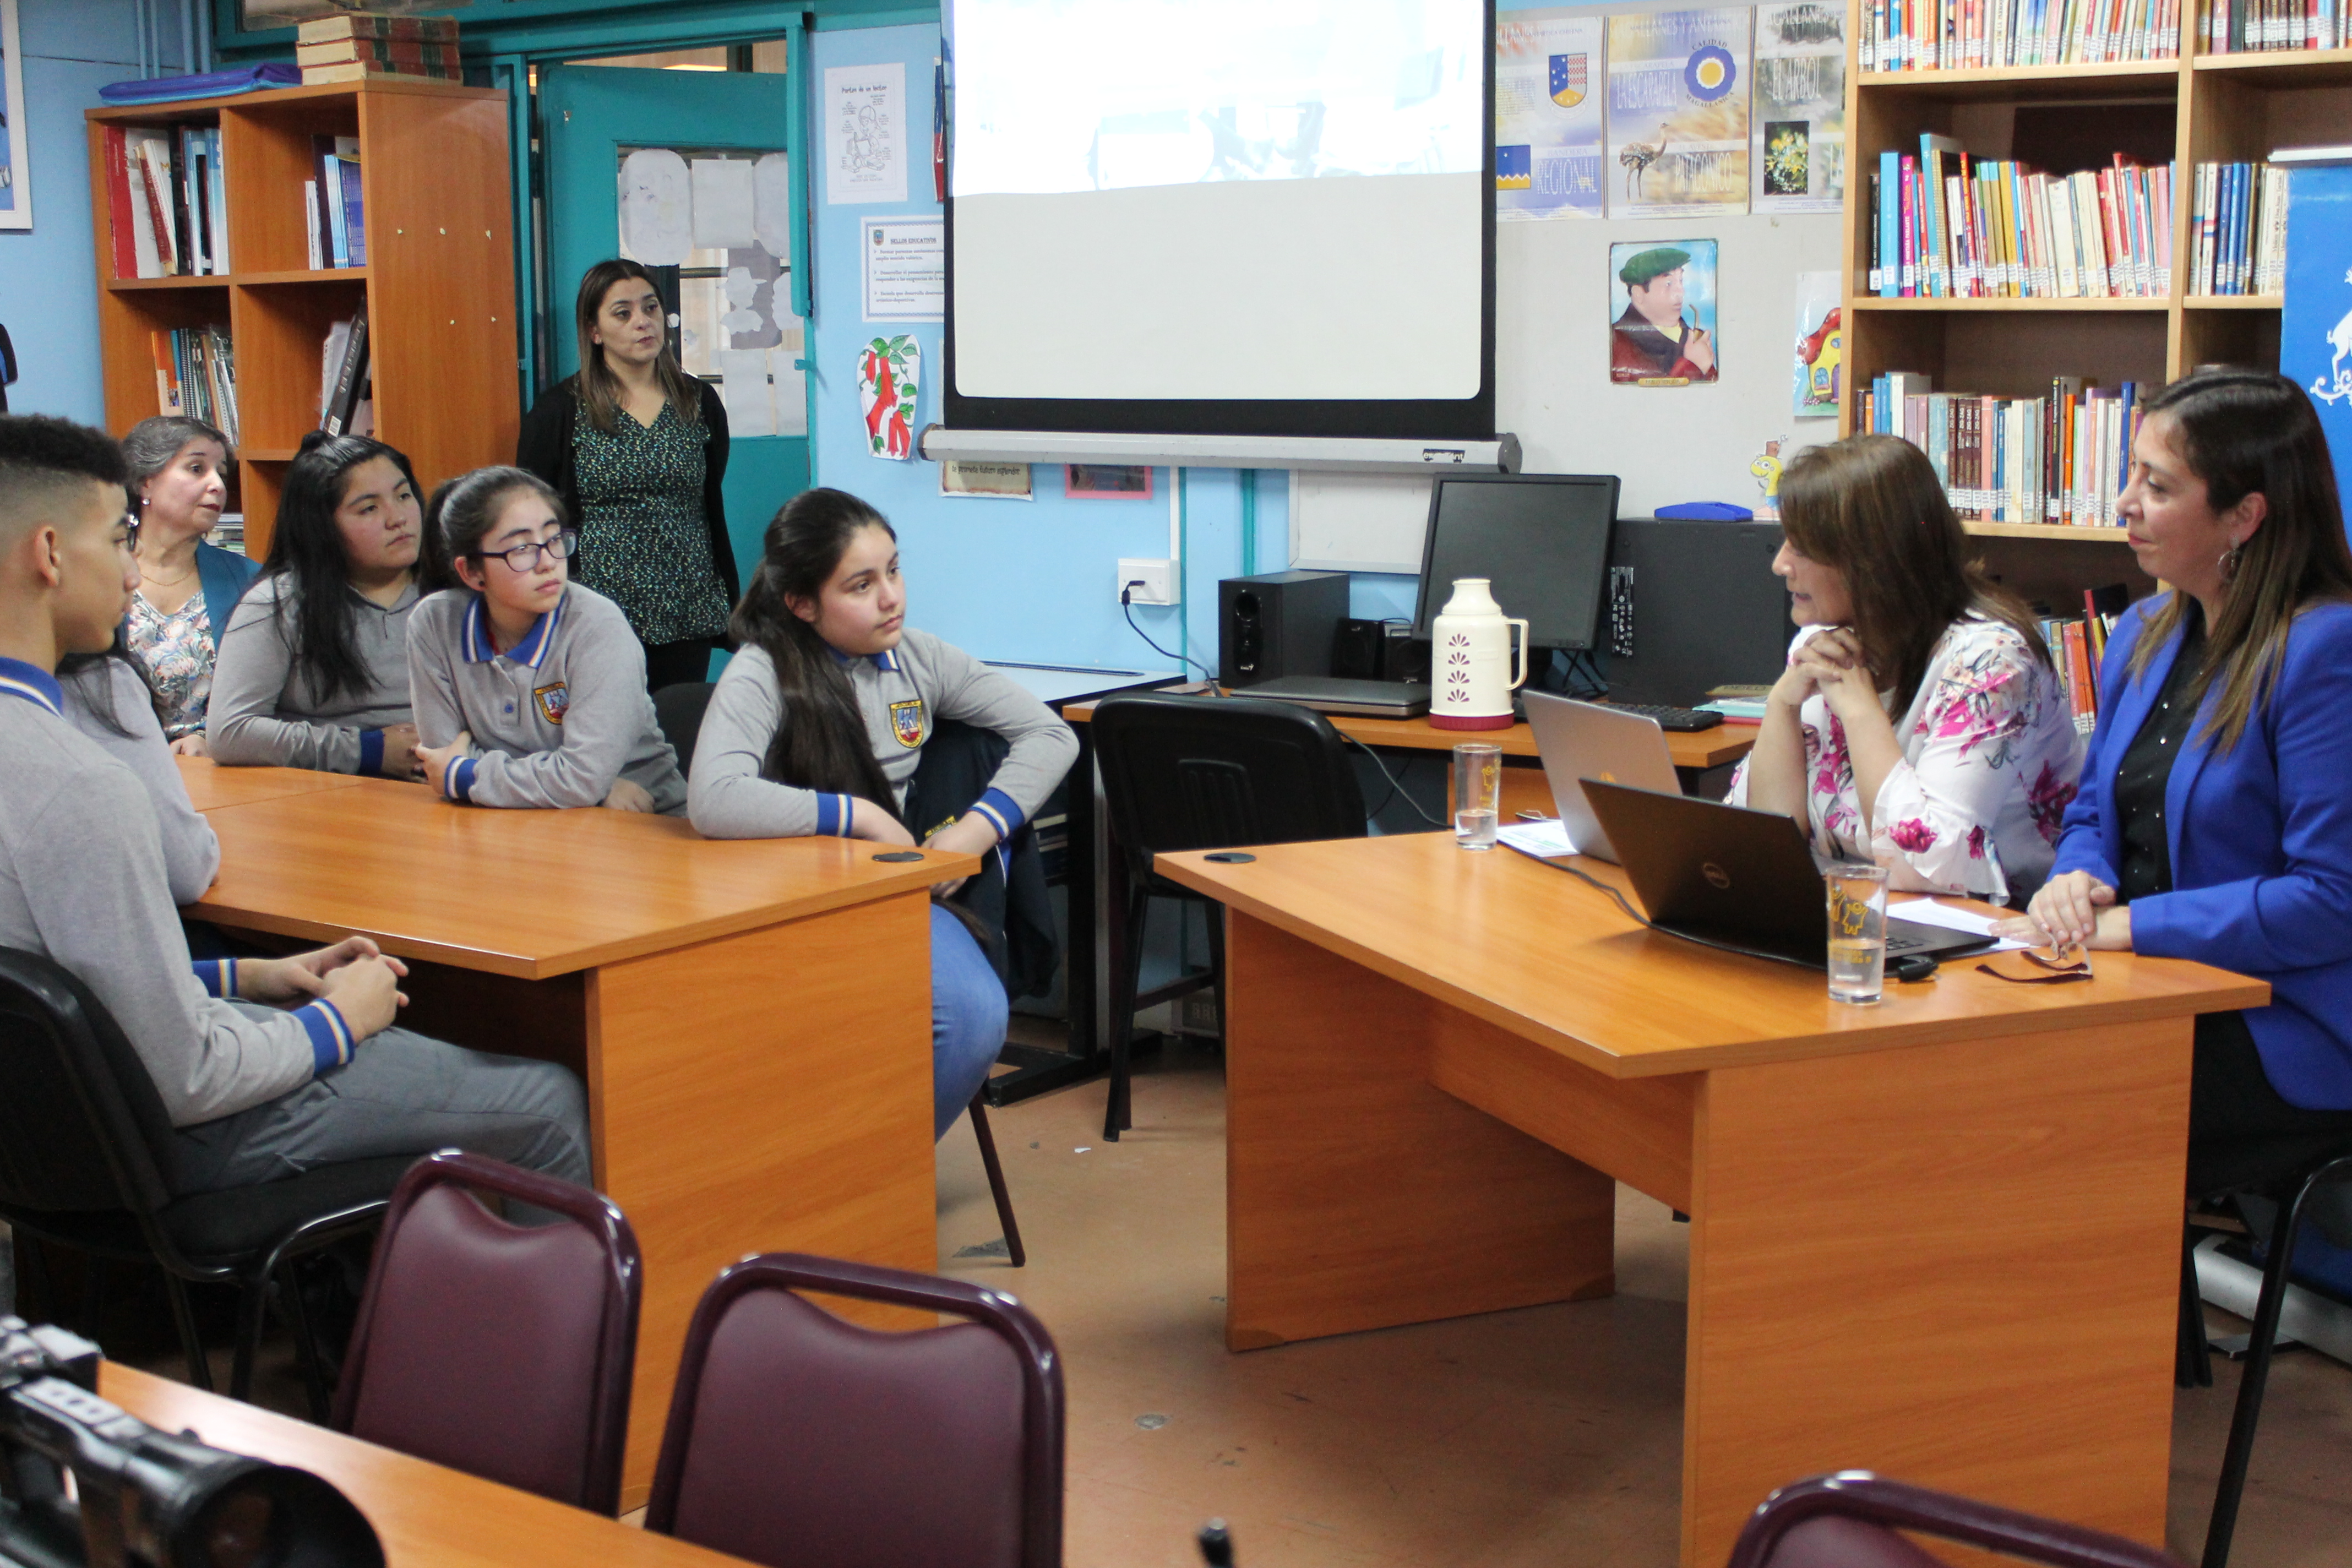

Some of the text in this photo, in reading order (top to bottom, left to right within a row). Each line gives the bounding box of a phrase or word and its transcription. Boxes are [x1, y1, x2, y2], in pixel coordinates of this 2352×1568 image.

[1692, 39, 1728, 51] CALIDAD
[1772, 57, 1822, 101] EL ARBOL
[1686, 90, 1734, 108] MAGALLANICA
[1538, 158, 1597, 195] REGIONAL
[1675, 153, 1732, 193] PATAGONICO
[958, 466, 978, 475] promete
[979, 465, 996, 473] futuro
